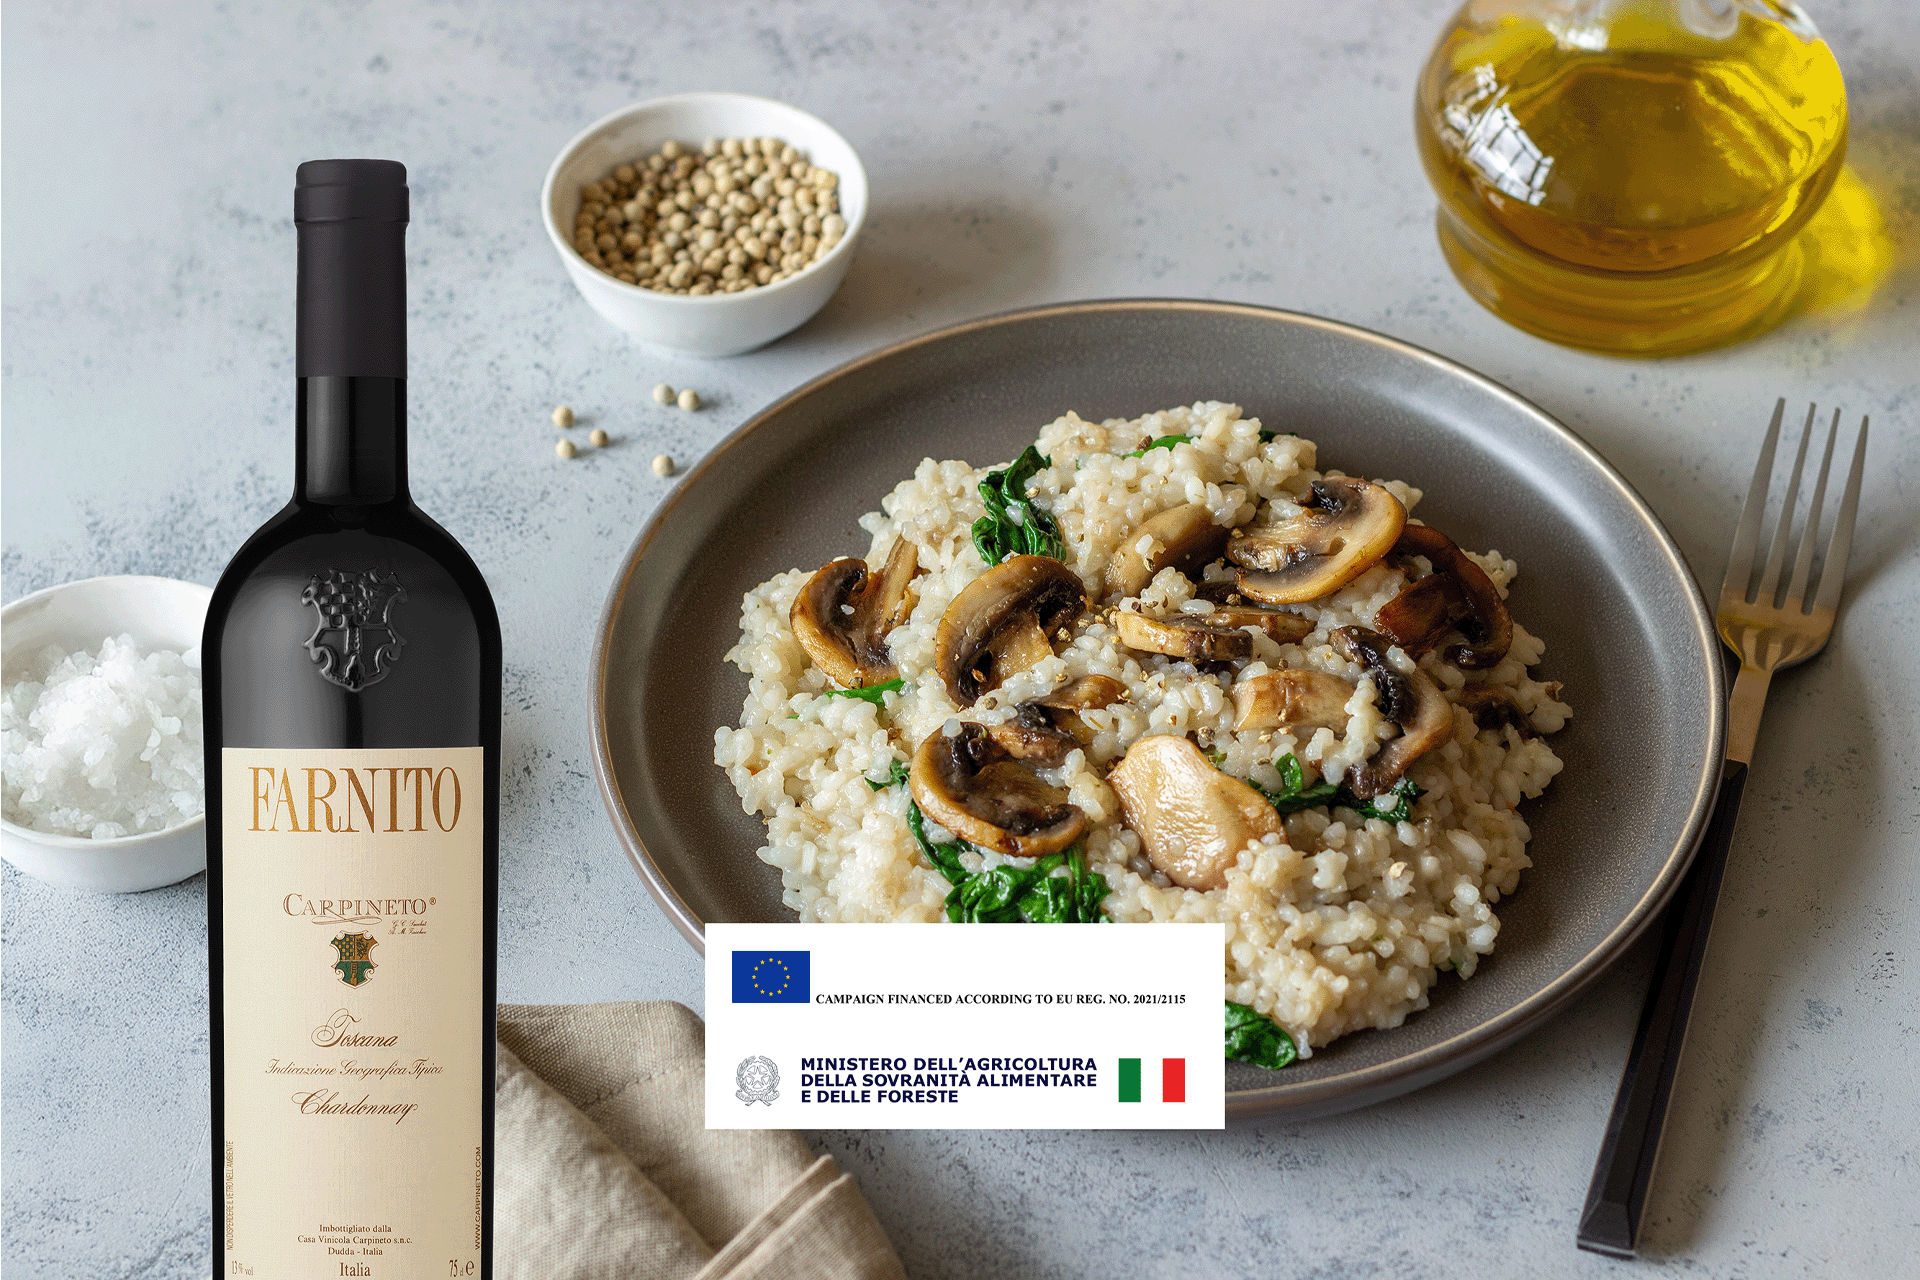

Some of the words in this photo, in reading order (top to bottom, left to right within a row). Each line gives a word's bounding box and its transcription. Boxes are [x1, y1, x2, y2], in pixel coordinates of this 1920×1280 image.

[248, 767, 461, 833] FARNITO
[311, 1008, 398, 1047] Toscana
[265, 1058, 337, 1076] Indicazione
[339, 1060, 407, 1081] Geografica
[408, 1057, 443, 1079] Tipica
[291, 1088, 418, 1125] Chardonnay
[319, 1224, 371, 1234] Imbottigliato
[372, 1225, 392, 1233] dalla
[297, 1235, 316, 1243] Casa
[318, 1235, 351, 1244] Vinicola
[352, 1236, 392, 1245] Carpineto
[328, 1247, 355, 1255] Dudda
[340, 1262, 371, 1276] Italia
[449, 1259, 458, 1277] 75
